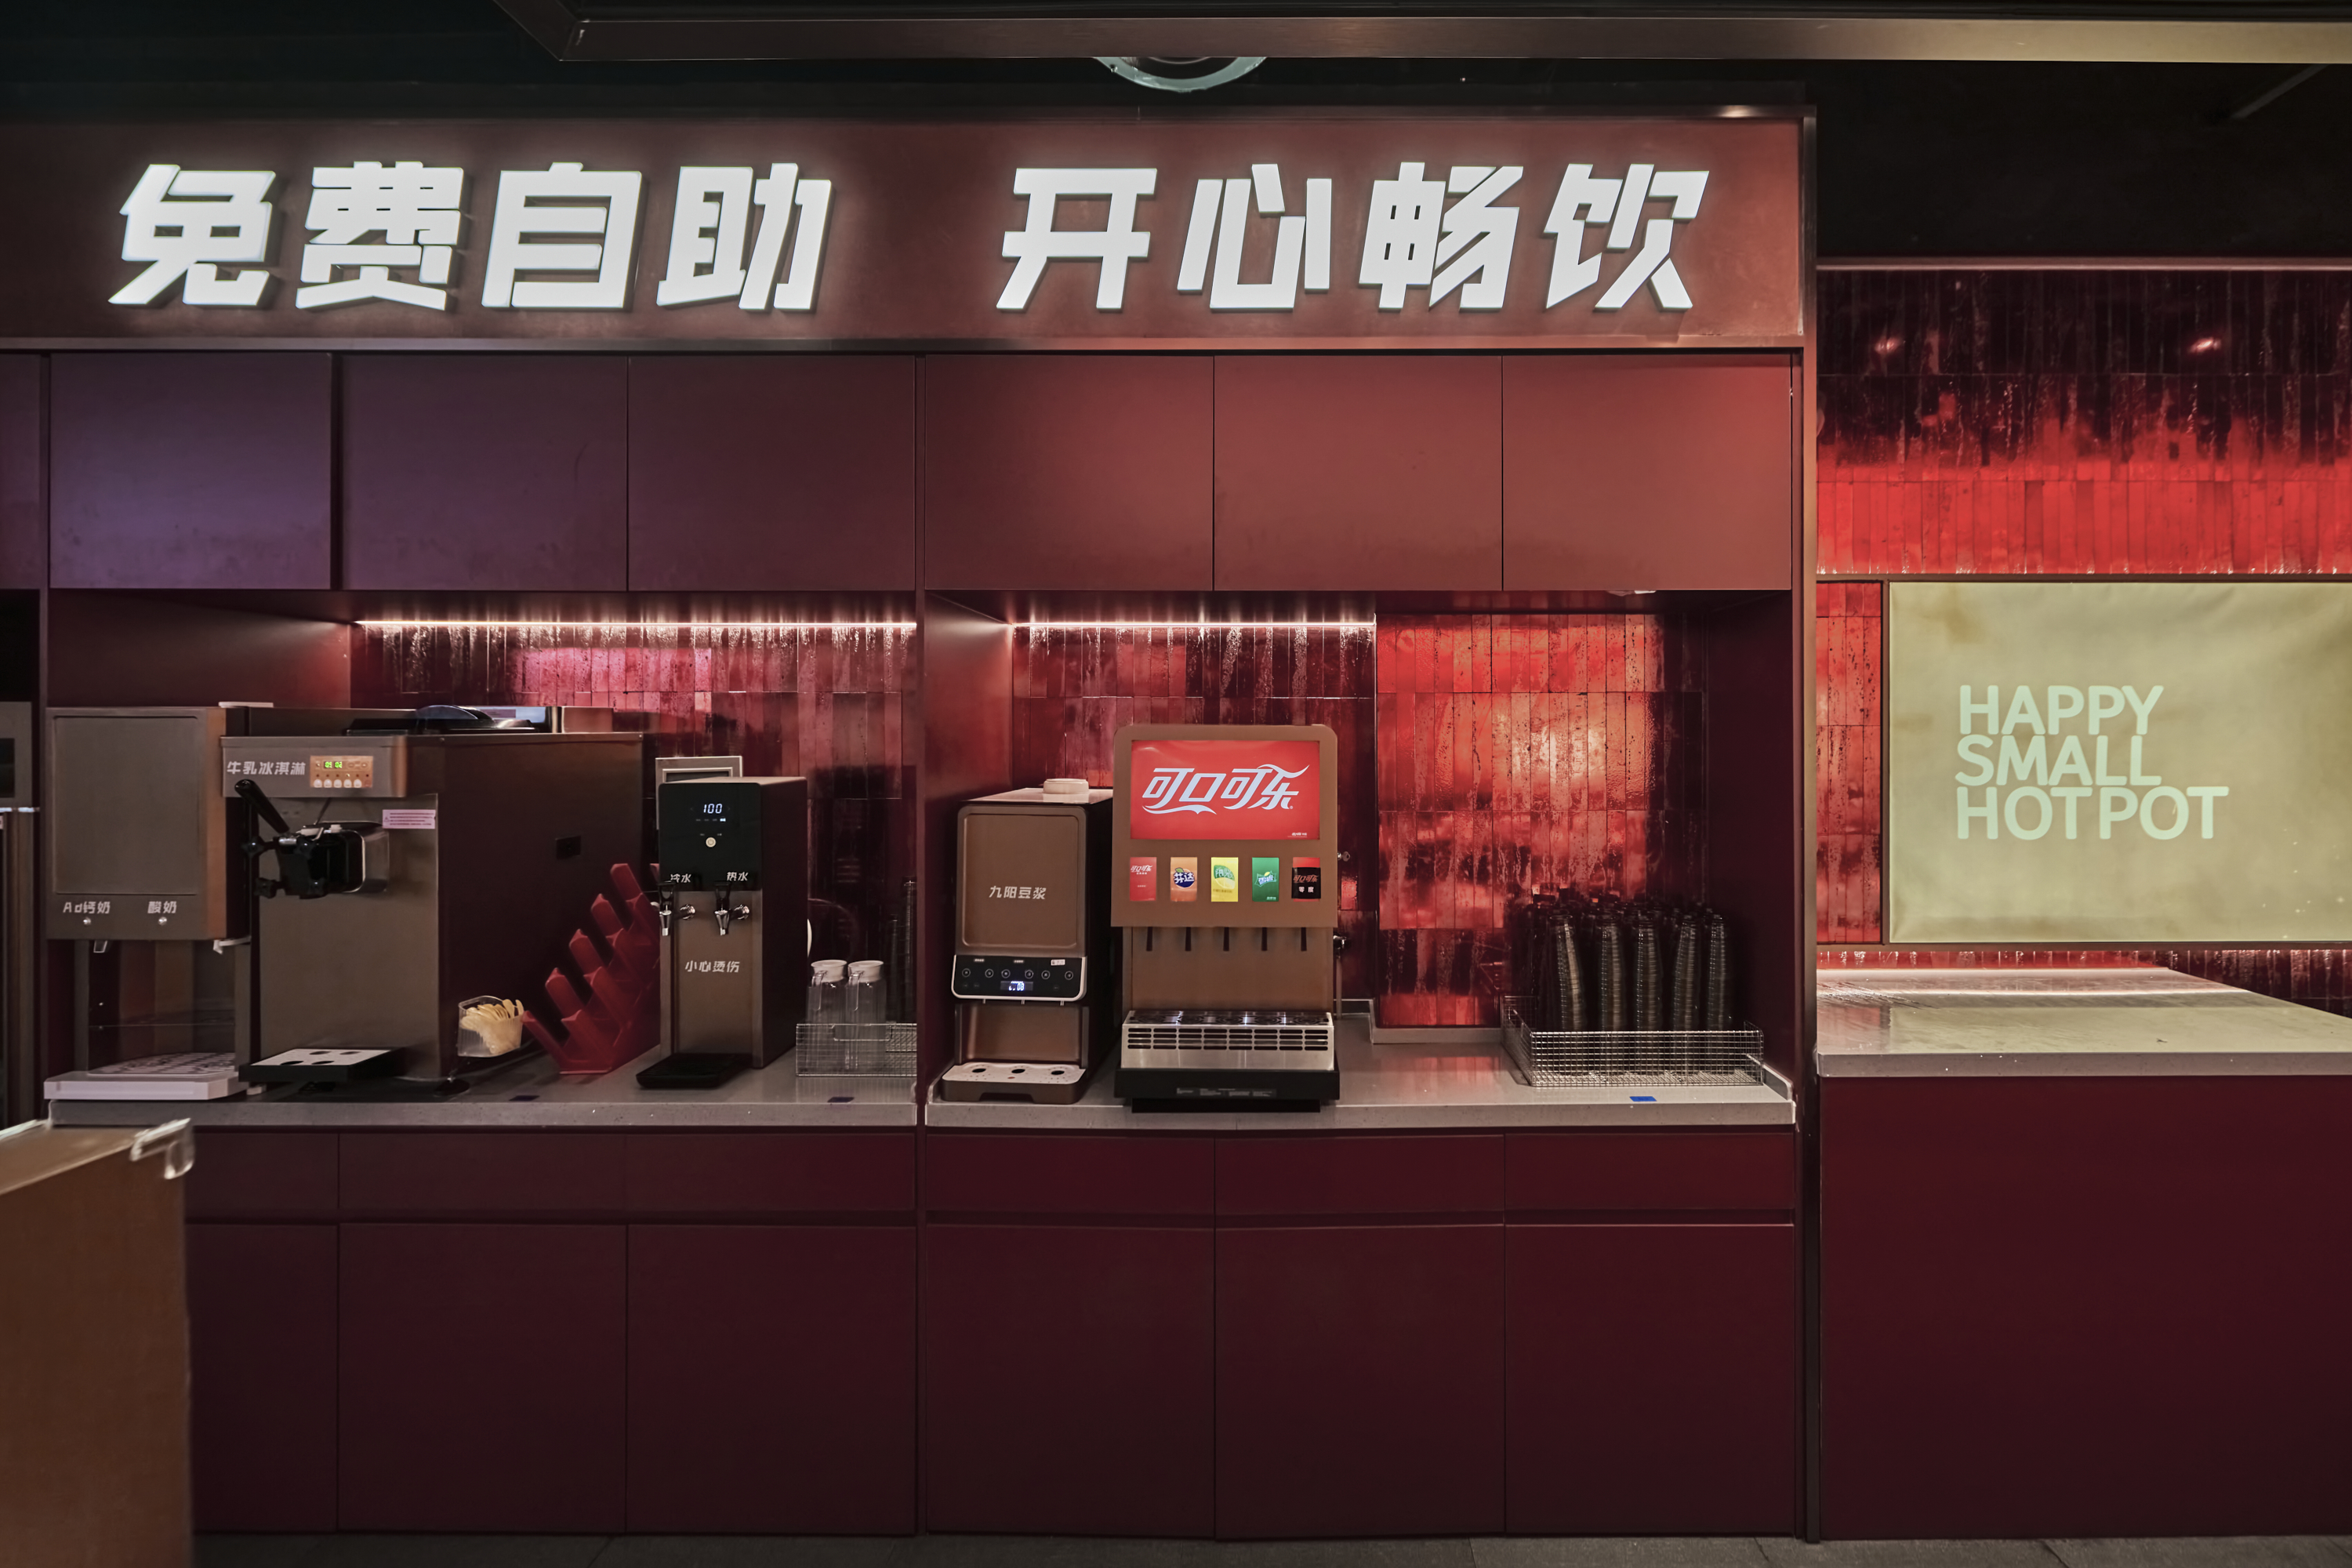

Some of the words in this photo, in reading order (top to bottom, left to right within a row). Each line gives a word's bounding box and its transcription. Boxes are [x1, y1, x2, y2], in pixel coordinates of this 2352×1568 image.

[107, 161, 831, 310] 免费自助
[996, 162, 1709, 311] 开心畅饮
[1960, 684, 2165, 735] HAPPY
[1955, 735, 2162, 786] SMALL
[227, 760, 307, 775] 牛乳冰淇淋
[1142, 764, 1310, 815] 可口可乐
[703, 803, 723, 814] 100
[670, 873, 691, 883] 冷水
[1174, 872, 1195, 884] 芬达
[1293, 874, 1319, 884] 可口可乐
[989, 885, 1047, 900] 九阳豆浆
[63, 901, 111, 913] Ad钙奶
[147, 901, 177, 913] 酸奶
[685, 960, 740, 972] 小心烫伤
